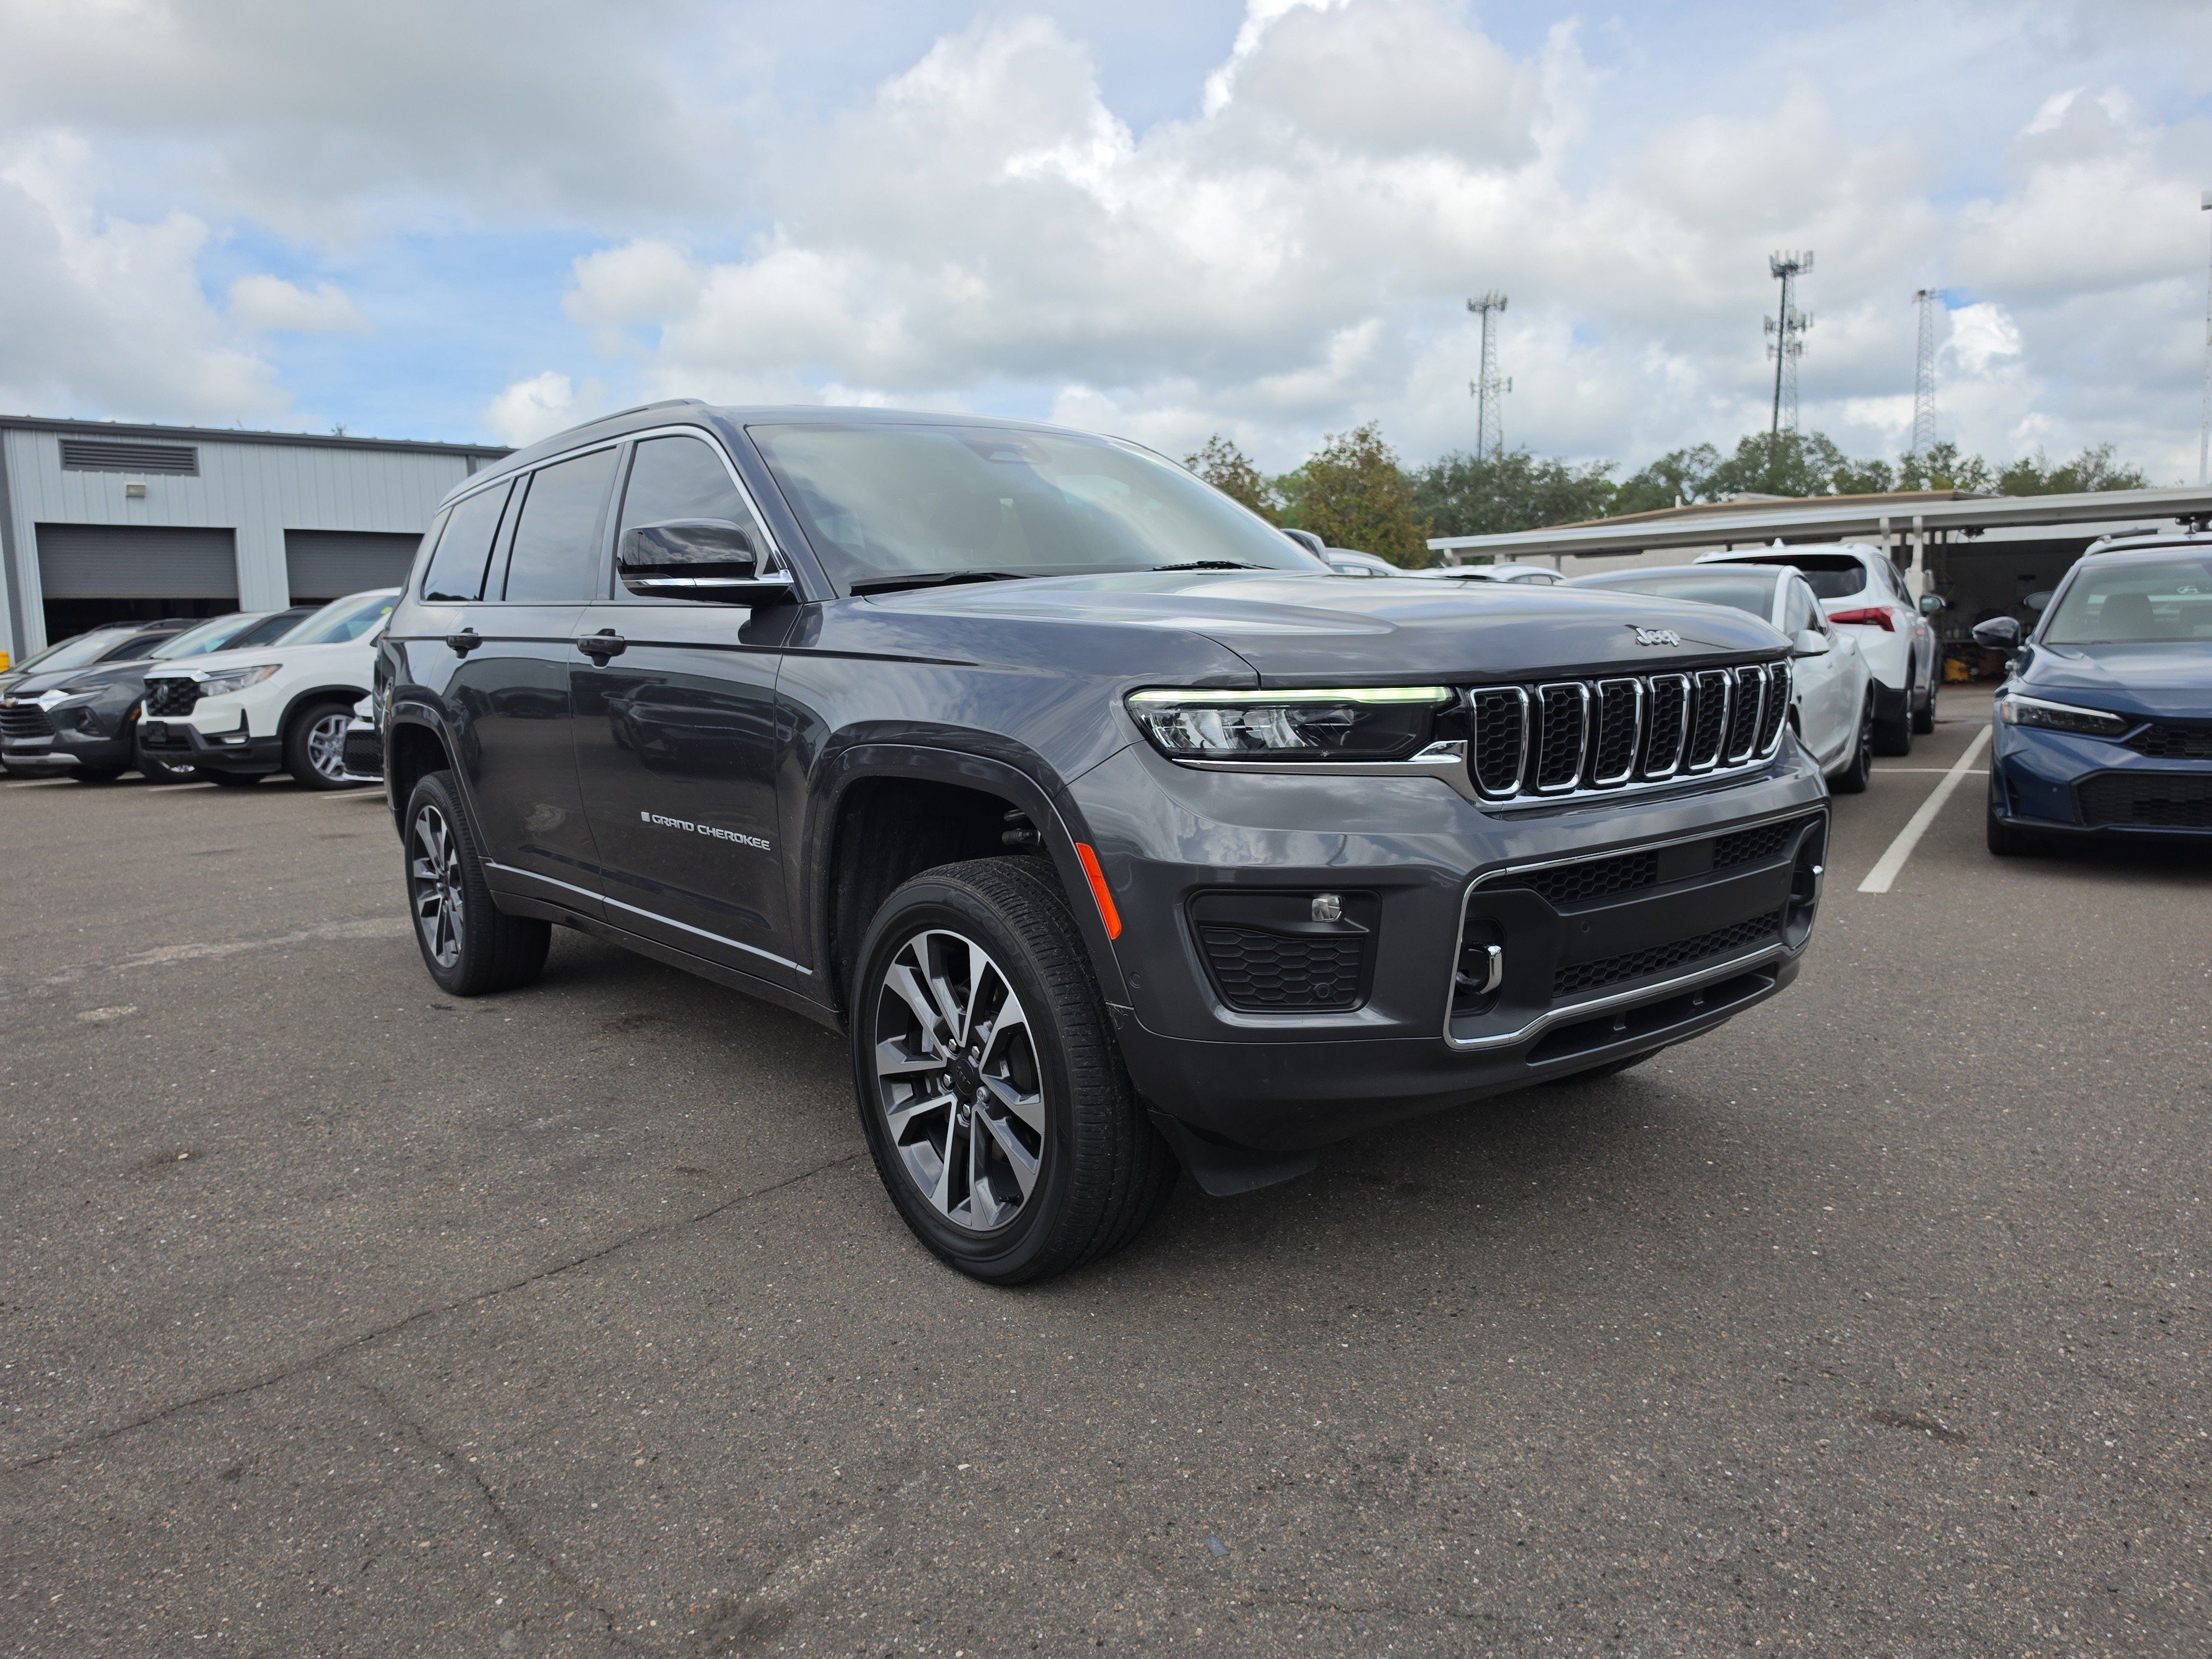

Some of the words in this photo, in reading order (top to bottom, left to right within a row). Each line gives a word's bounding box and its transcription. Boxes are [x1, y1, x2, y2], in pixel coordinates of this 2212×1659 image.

[1636, 627, 1681, 647] Jeep
[652, 814, 695, 832] GRAND
[697, 824, 771, 851] CHEROKEE
